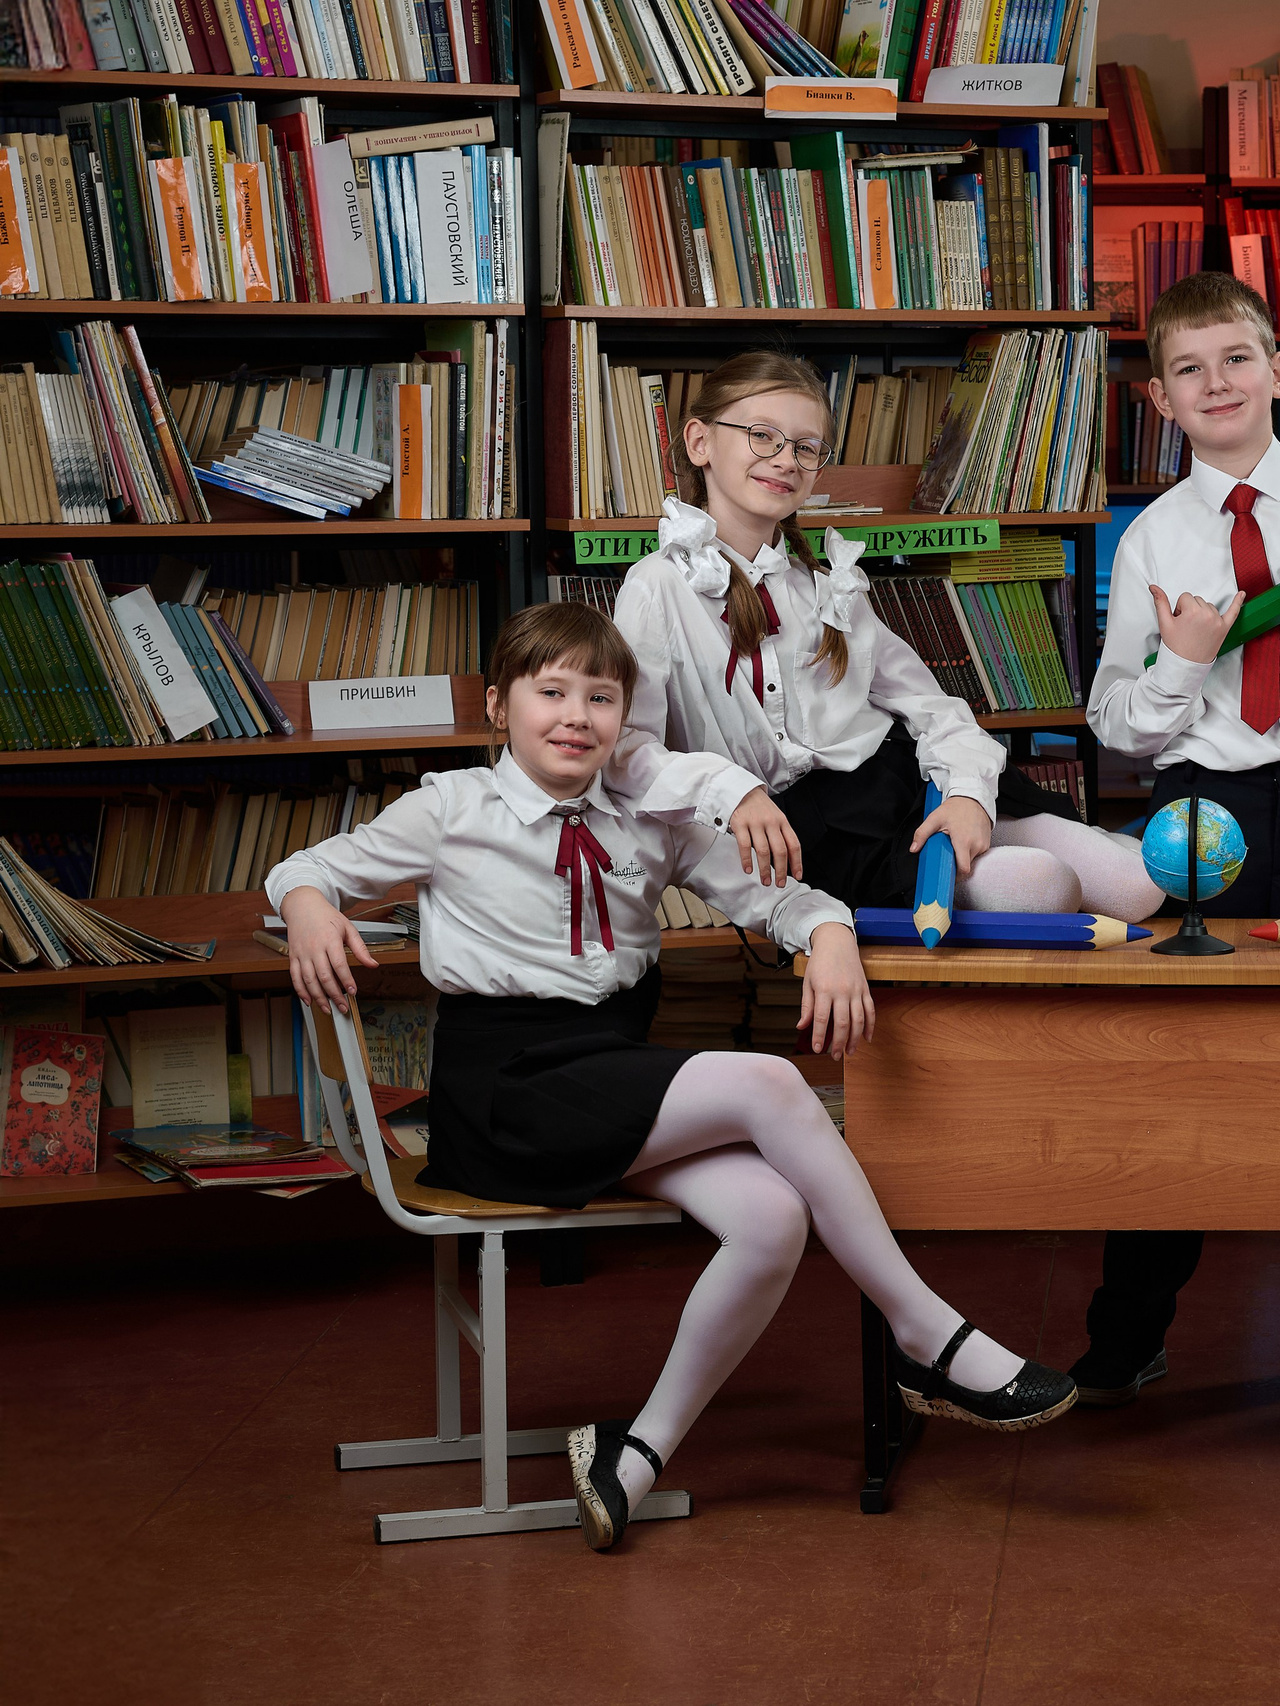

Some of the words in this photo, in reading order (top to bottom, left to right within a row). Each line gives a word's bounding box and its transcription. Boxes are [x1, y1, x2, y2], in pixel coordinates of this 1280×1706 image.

[157, 16, 170, 42] СКАЗКИ
[169, 16, 182, 42] СКАЗКИ
[186, 23, 195, 36] ЗА
[208, 23, 217, 36] ЗА
[231, 34, 241, 46] ЗА
[272, 9, 288, 53] СКАЗКИ
[565, 21, 581, 69] Рассказы
[923, 22, 936, 60] ВРЕМЕНА
[715, 36, 744, 87] БРОДЯГИ
[950, 31, 960, 63] ЖИТКОВ
[960, 30, 969, 63] ЖИТКОВ
[968, 31, 978, 64] ЖИТКОВ
[805, 90, 843, 101] Бианки
[845, 92, 856, 101] В.
[961, 79, 1023, 92] ЖИТКОВ
[1237, 89, 1248, 157] Математика
[374, 134, 417, 147] ИЗБРАННОЕ
[80, 172, 92, 213] ШКАТУЛКА
[176, 206, 187, 241] Ершов
[243, 191, 255, 239] Сибиряк
[343, 180, 363, 241] ОЛЕША
[873, 216, 881, 228] Н.
[441, 171, 468, 286] ПАУСТОВСКИЙ
[181, 244, 190, 257] П.
[874, 229, 883, 271] Сладков
[401, 424, 410, 435] А.
[401, 438, 410, 478] Толстой
[578, 537, 632, 558] ЭТИ
[865, 526, 988, 554] ДРУЖИТЬ
[132, 623, 175, 687] КРЫЛОВ
[340, 685, 417, 701] ПРИШВИН
[27, 1081, 64, 1090] ЛАПОТНИЦА
